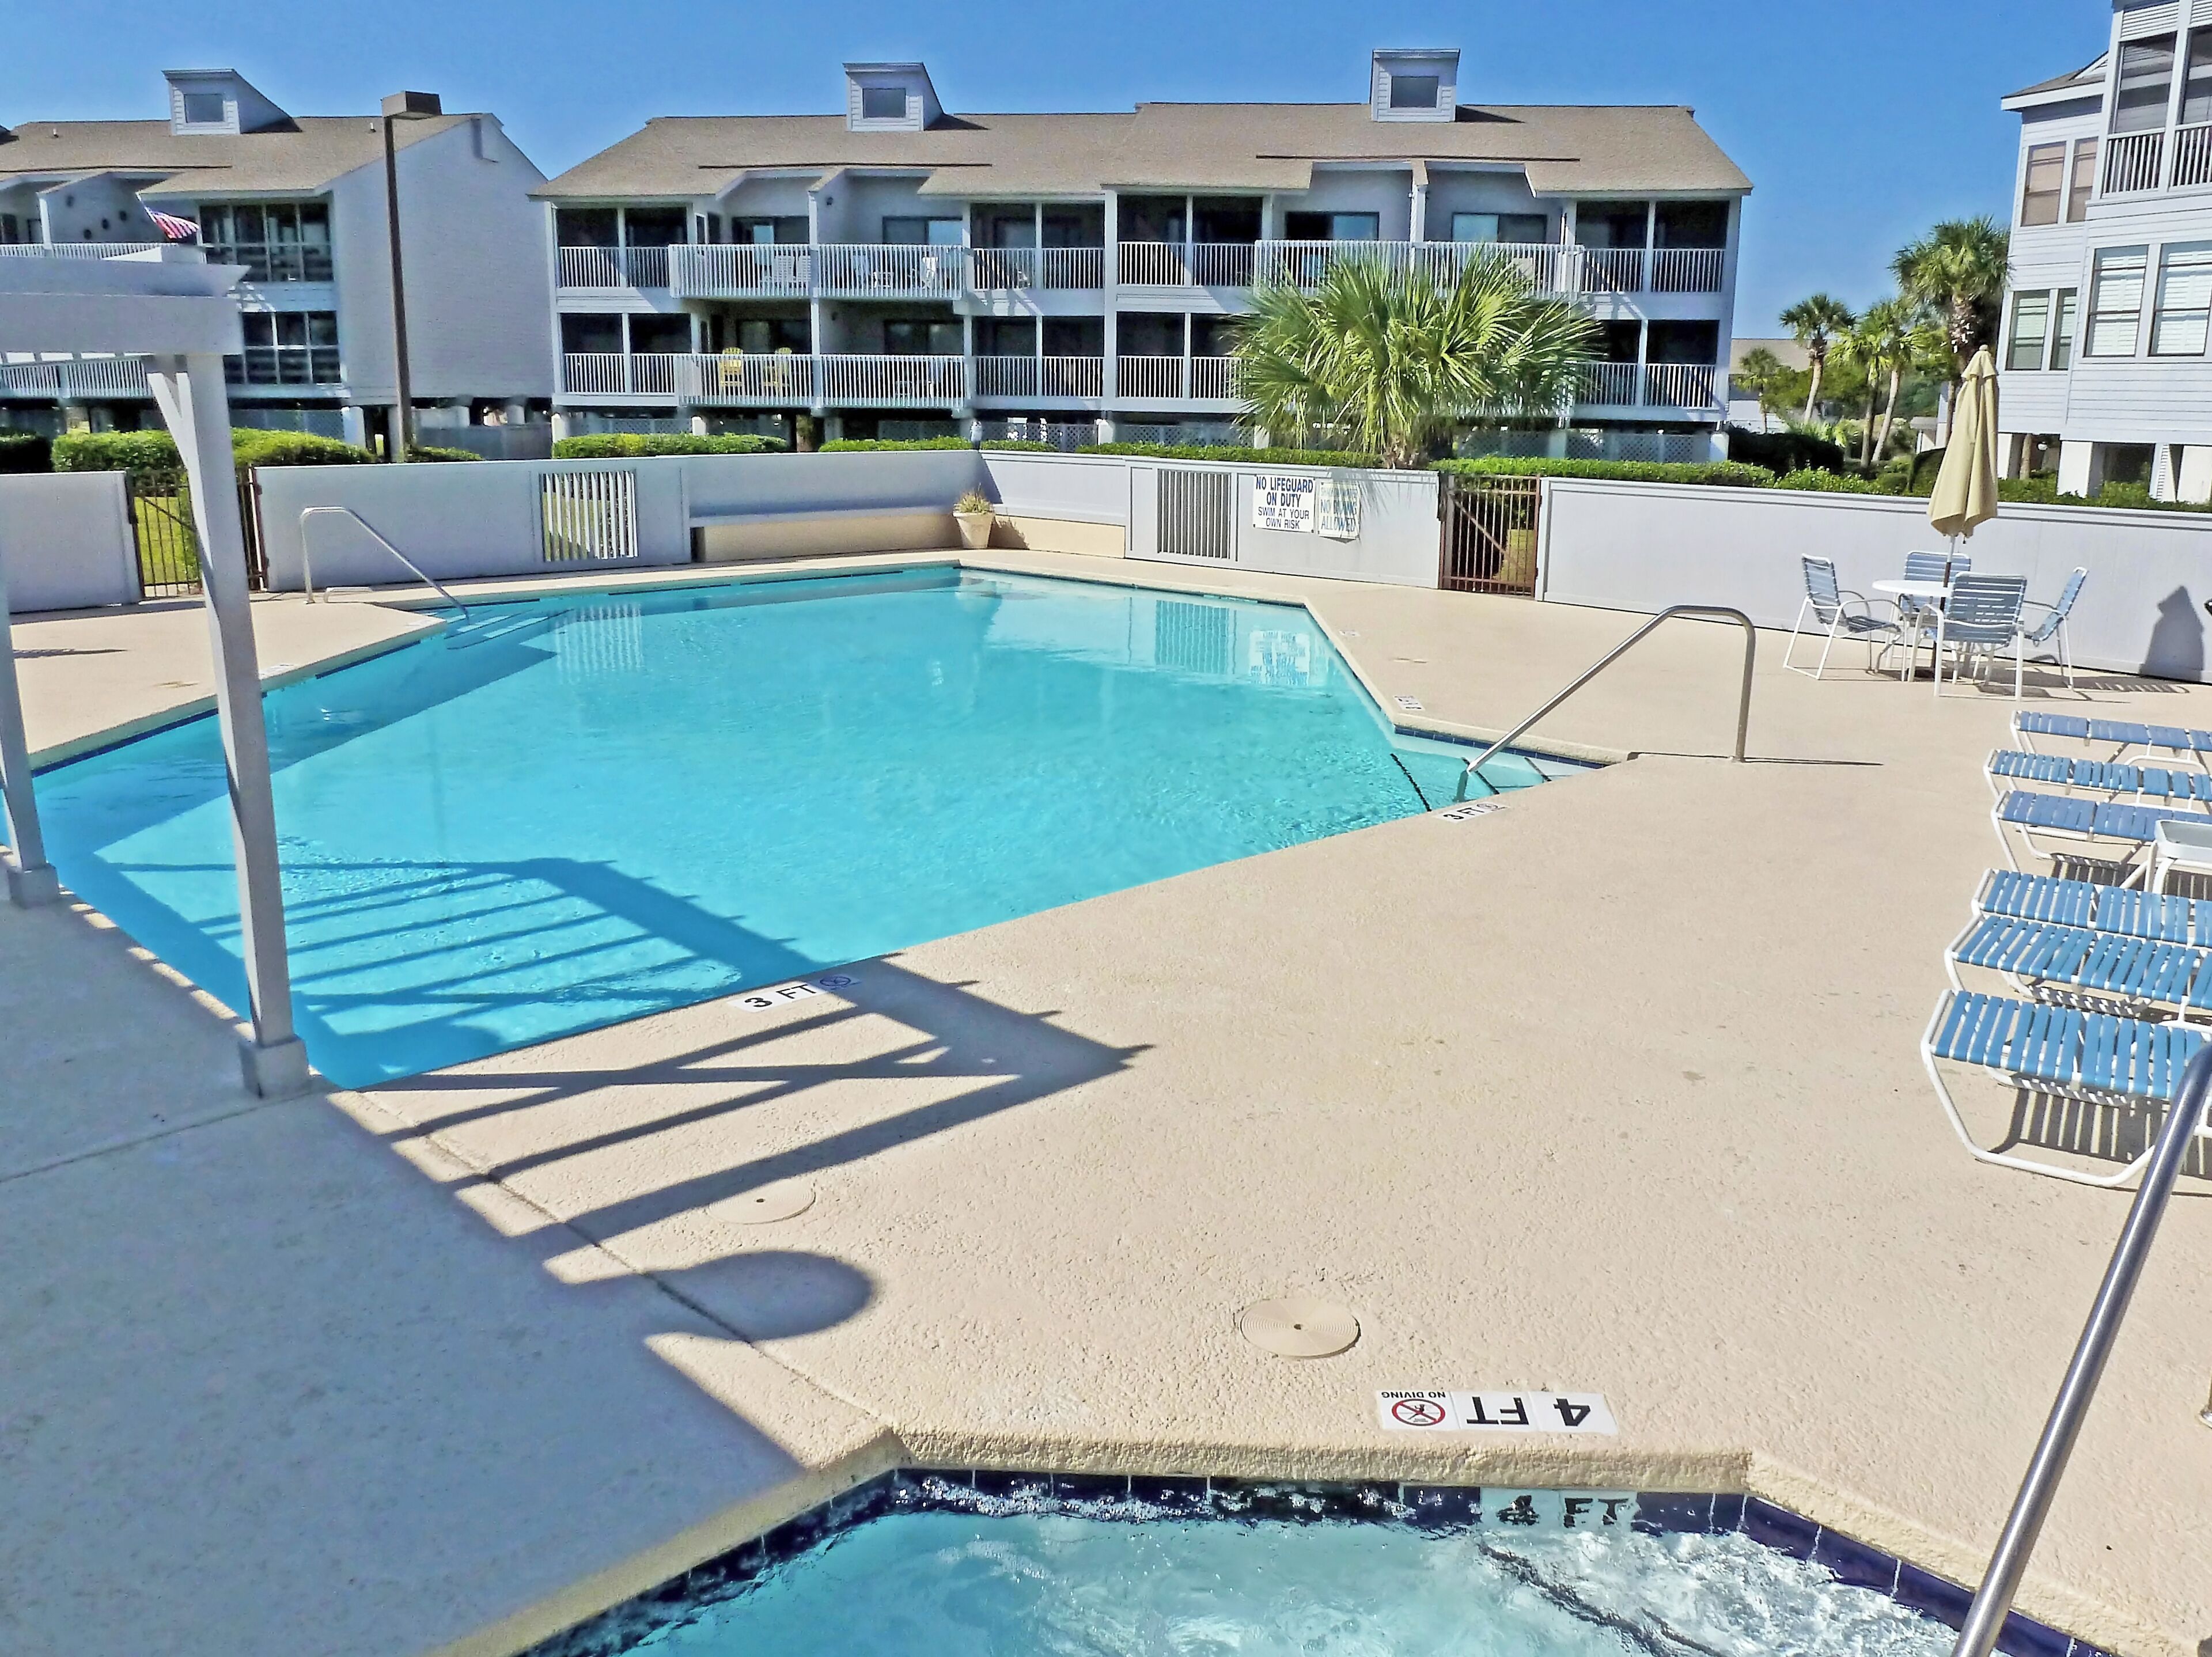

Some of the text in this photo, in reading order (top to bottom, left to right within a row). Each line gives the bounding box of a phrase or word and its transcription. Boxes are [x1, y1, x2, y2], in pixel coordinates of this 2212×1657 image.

[1256, 476, 1313, 493] NO LIFEGUARD
[1267, 492, 1301, 507] ON DUTY
[1321, 499, 1331, 514] NO
[1258, 507, 1309, 520] SWIM AT YOUR
[1266, 518, 1300, 529] OWN RISK
[1321, 515, 1356, 532] ALLOWED
[1457, 807, 1484, 816] FT
[744, 997, 772, 1007] 3
[775, 984, 816, 999] FT
[1466, 1396, 1592, 1427] 4 FT
[1563, 1497, 1630, 1529] FT
